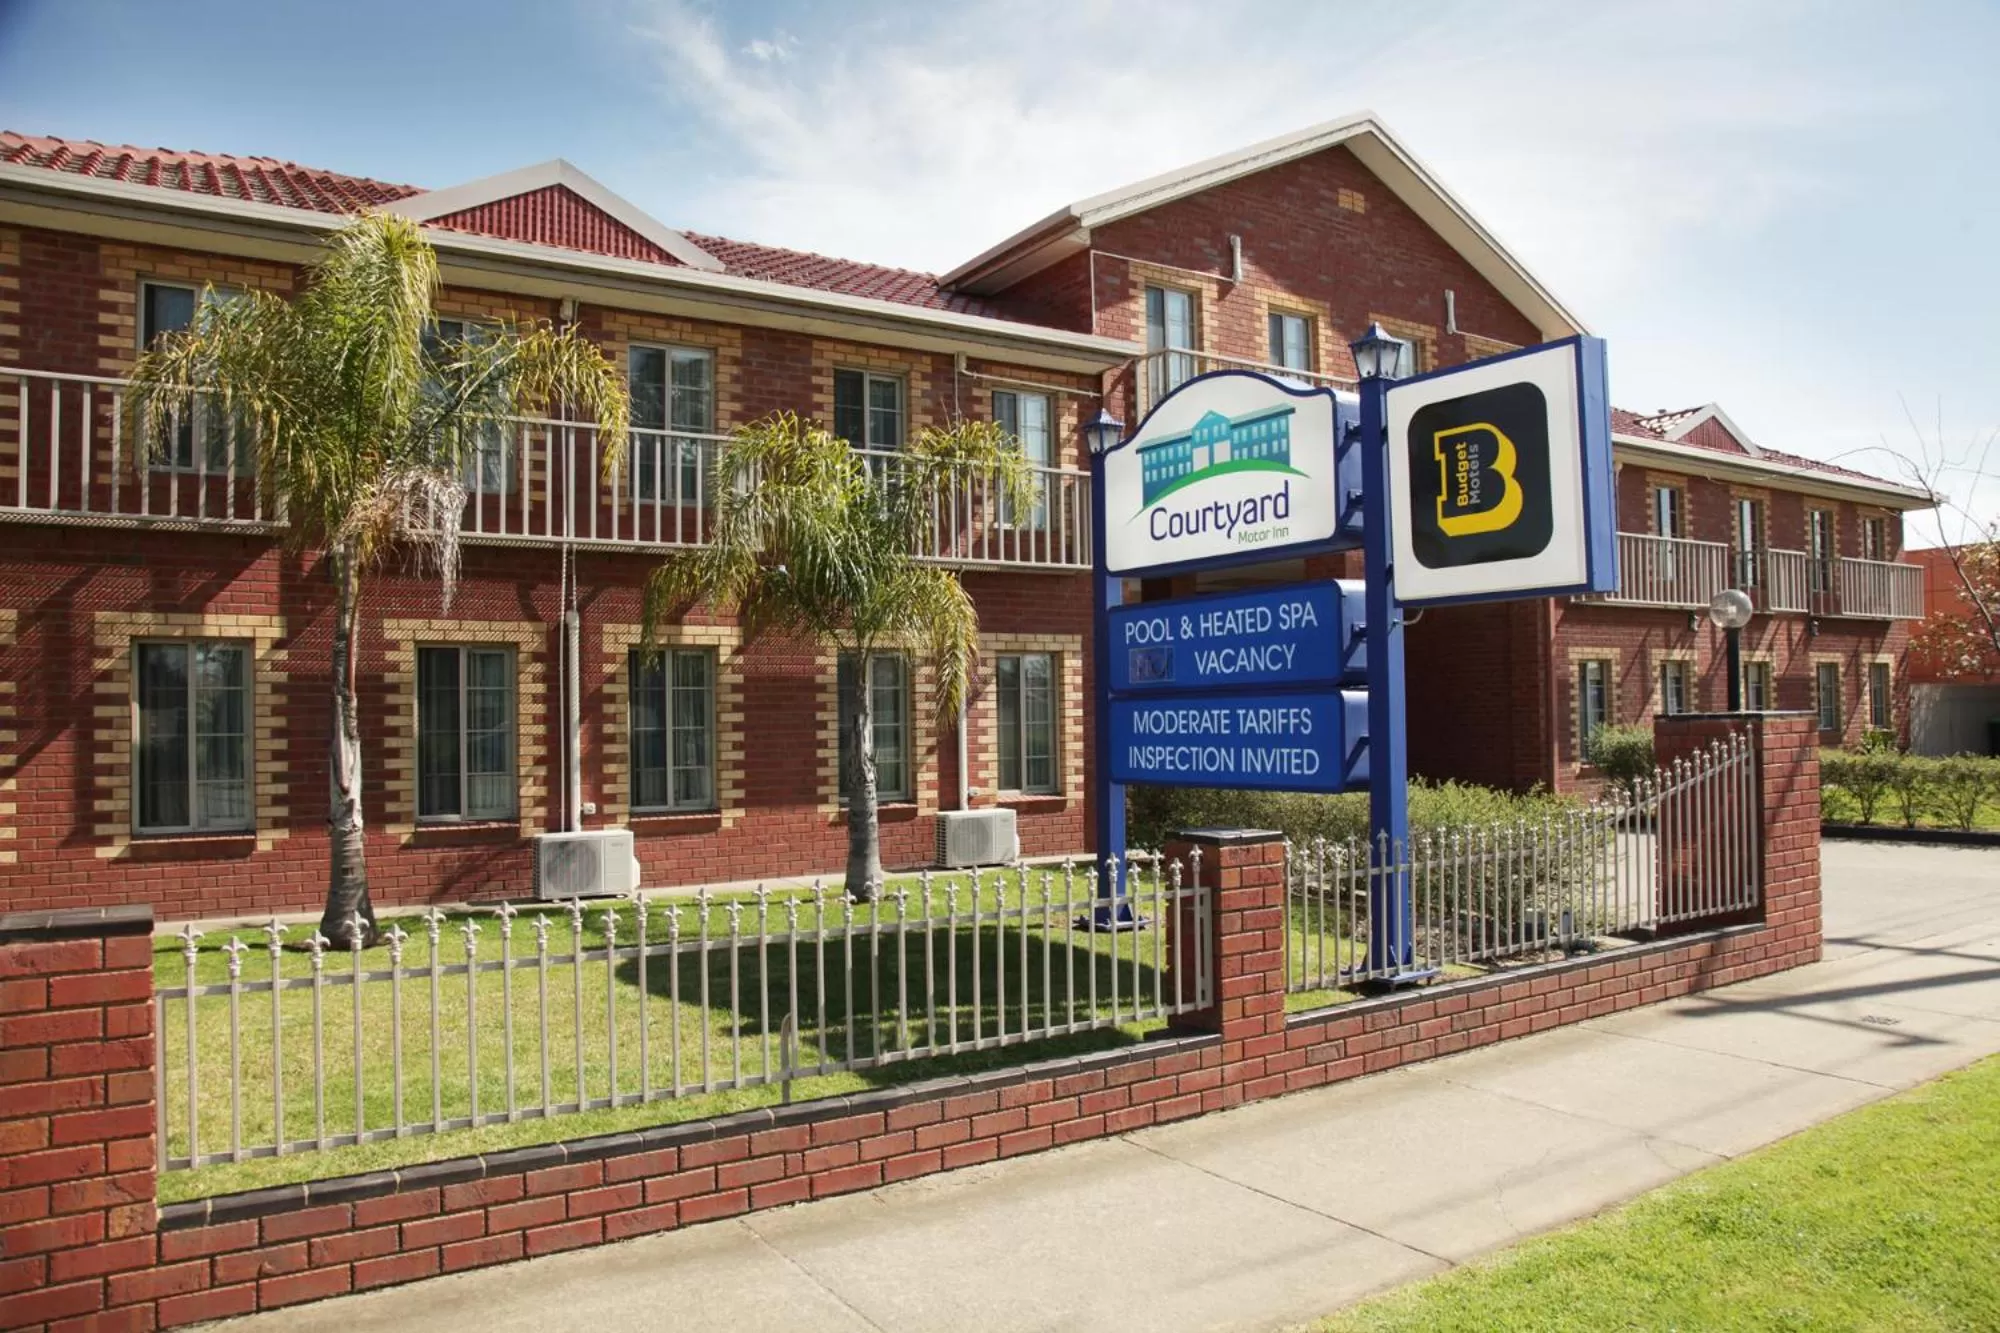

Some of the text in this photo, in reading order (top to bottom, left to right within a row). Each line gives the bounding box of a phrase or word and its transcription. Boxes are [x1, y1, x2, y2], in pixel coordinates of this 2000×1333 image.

[1456, 442, 1470, 507] Budget
[1470, 444, 1480, 504] Motels
[1150, 479, 1289, 541] Courtyard
[1238, 527, 1289, 544] Motor Inn
[1125, 601, 1318, 644] POOL & HEATED SPA
[1194, 643, 1297, 675] VACANCY
[1133, 708, 1312, 734] MODERATE TARIFFS
[1129, 746, 1320, 775] INSPECTION INVITED
